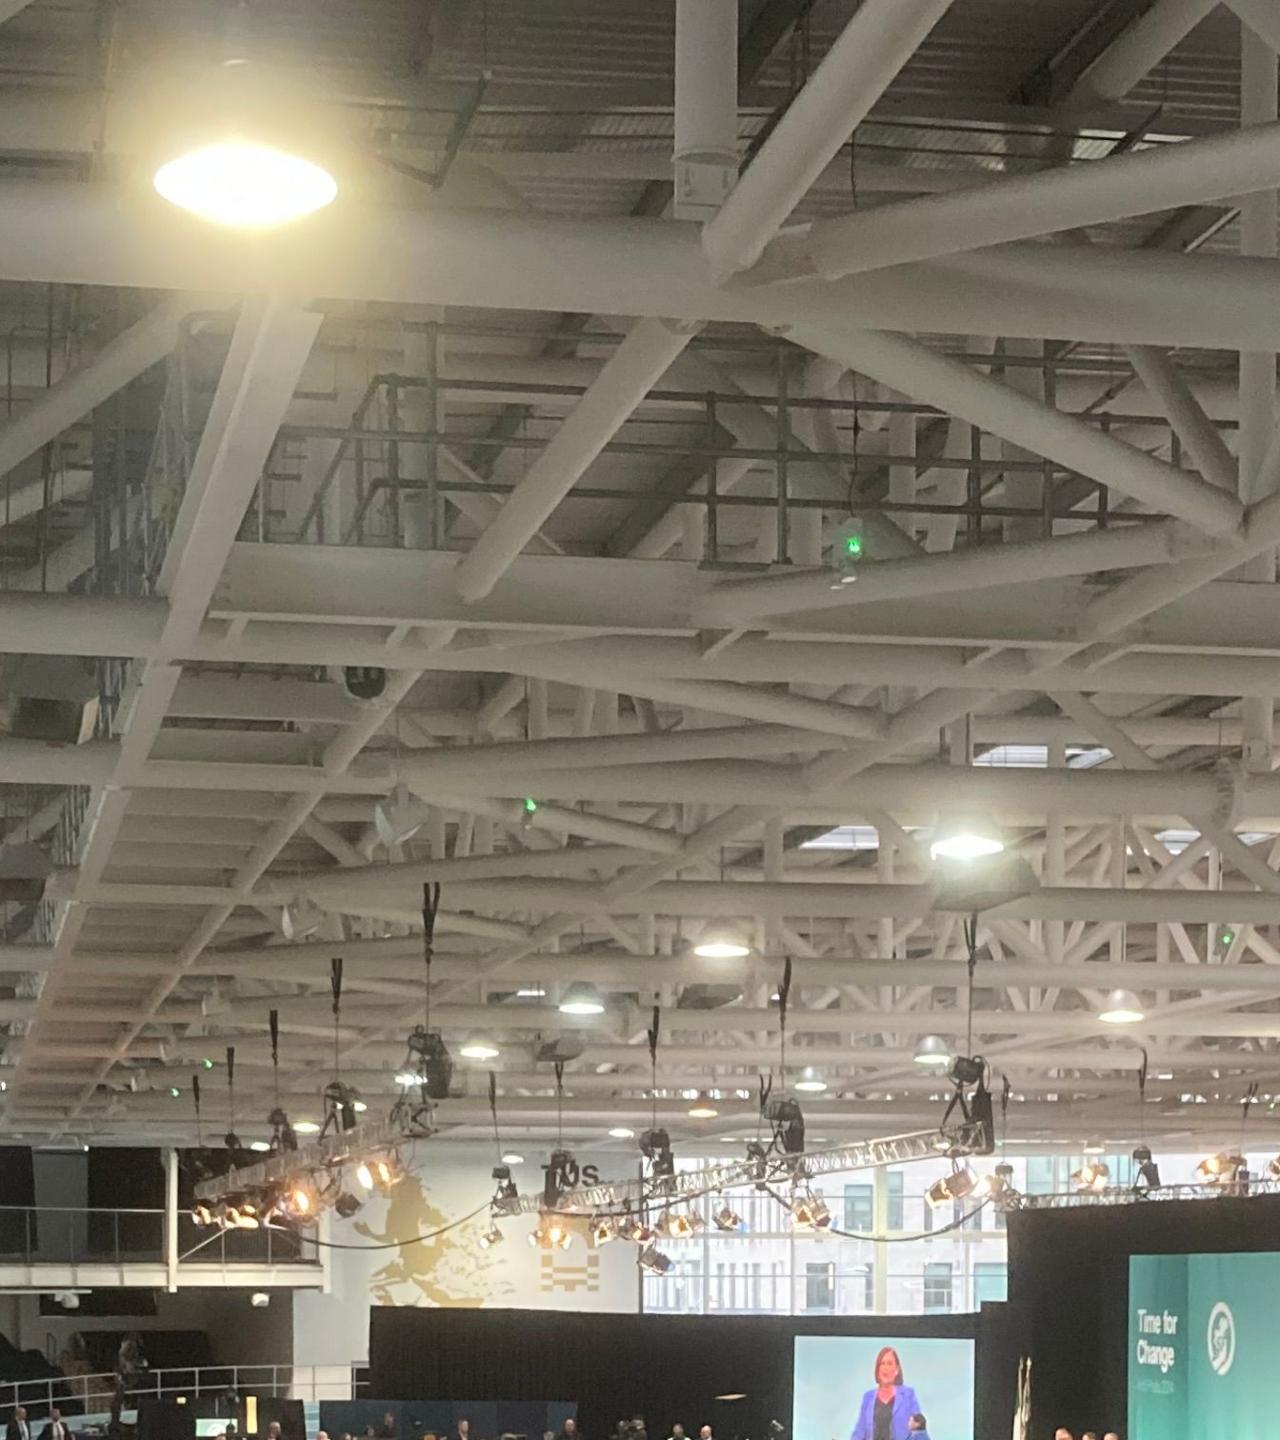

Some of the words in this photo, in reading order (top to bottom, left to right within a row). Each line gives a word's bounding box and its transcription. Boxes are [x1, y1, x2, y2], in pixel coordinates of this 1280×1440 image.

[1137, 1309, 1161, 1334] Time
[1163, 1310, 1178, 1334] for
[1137, 1339, 1175, 1373] Change
